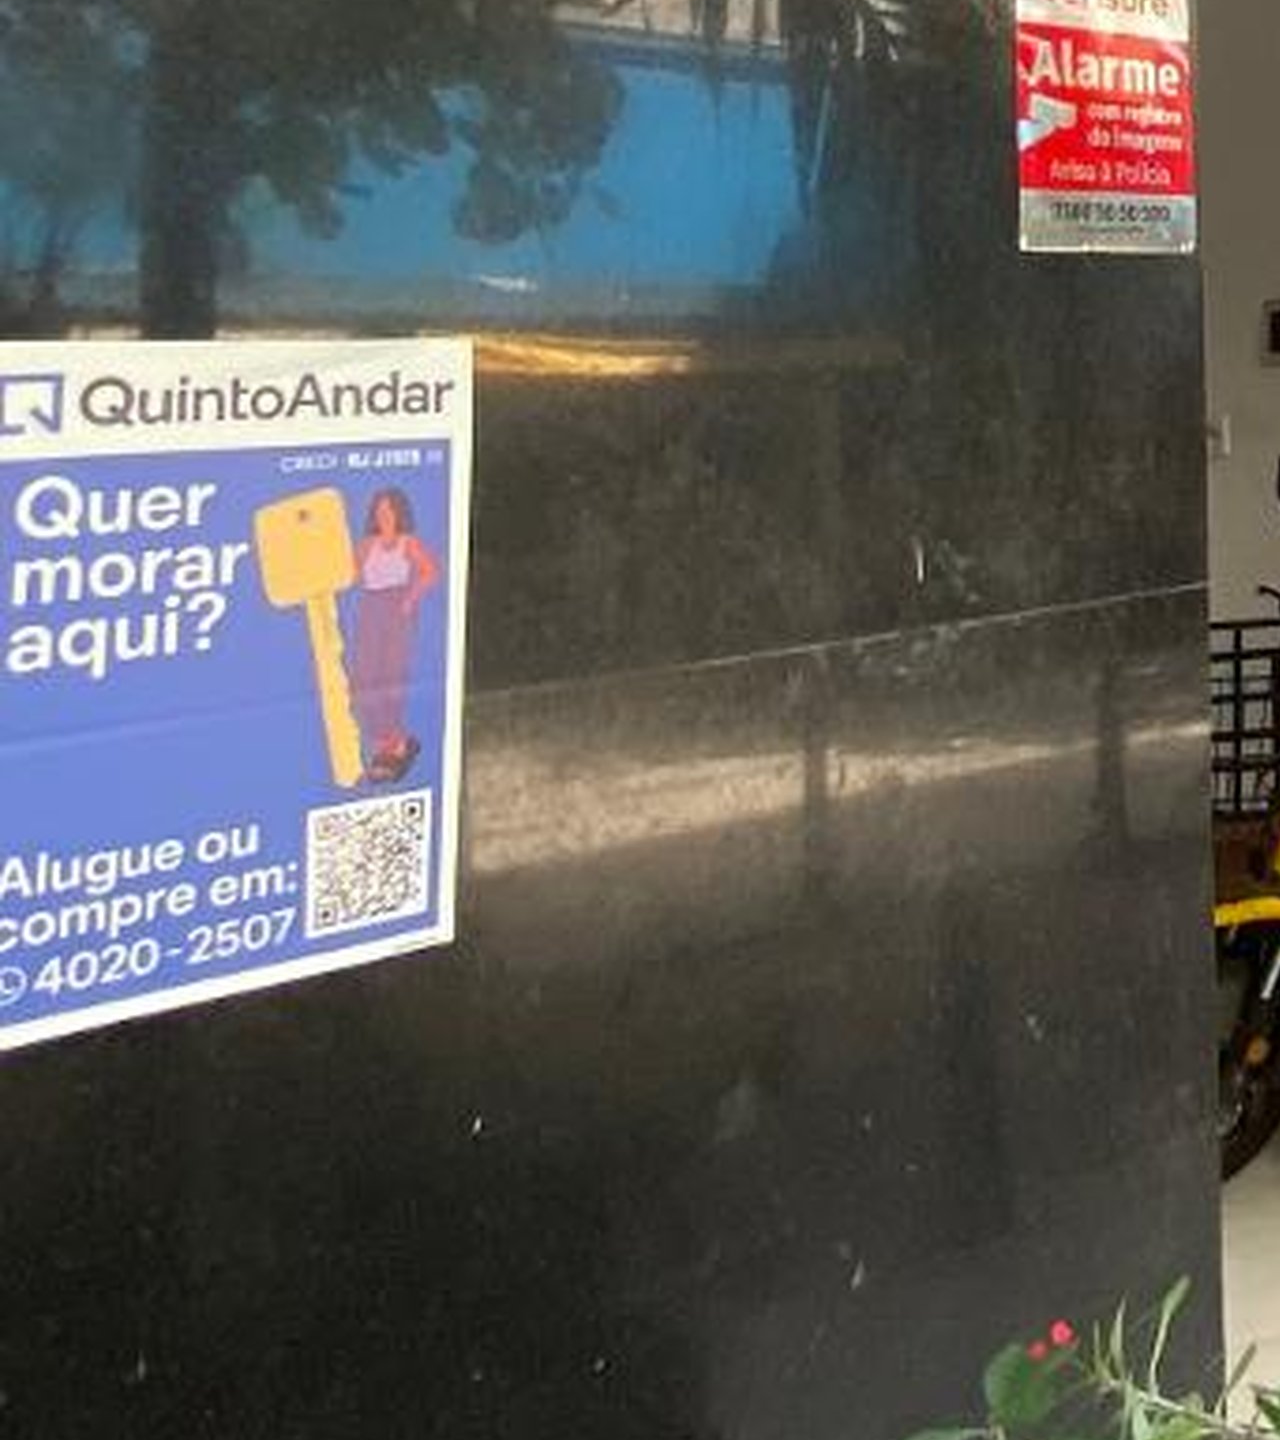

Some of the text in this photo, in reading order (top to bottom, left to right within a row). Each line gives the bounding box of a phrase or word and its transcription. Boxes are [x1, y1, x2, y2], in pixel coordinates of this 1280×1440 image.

[1028, 39, 1181, 96] Alarme
[80, 370, 455, 427] QuintoAndar
[15, 474, 217, 539] Quer
[12, 541, 249, 607] morar
[7, 591, 227, 679] aqui?
[0, 824, 260, 899] Alugue ou
[0, 860, 299, 952] compre em:
[33, 906, 297, 997] 4020-2507
